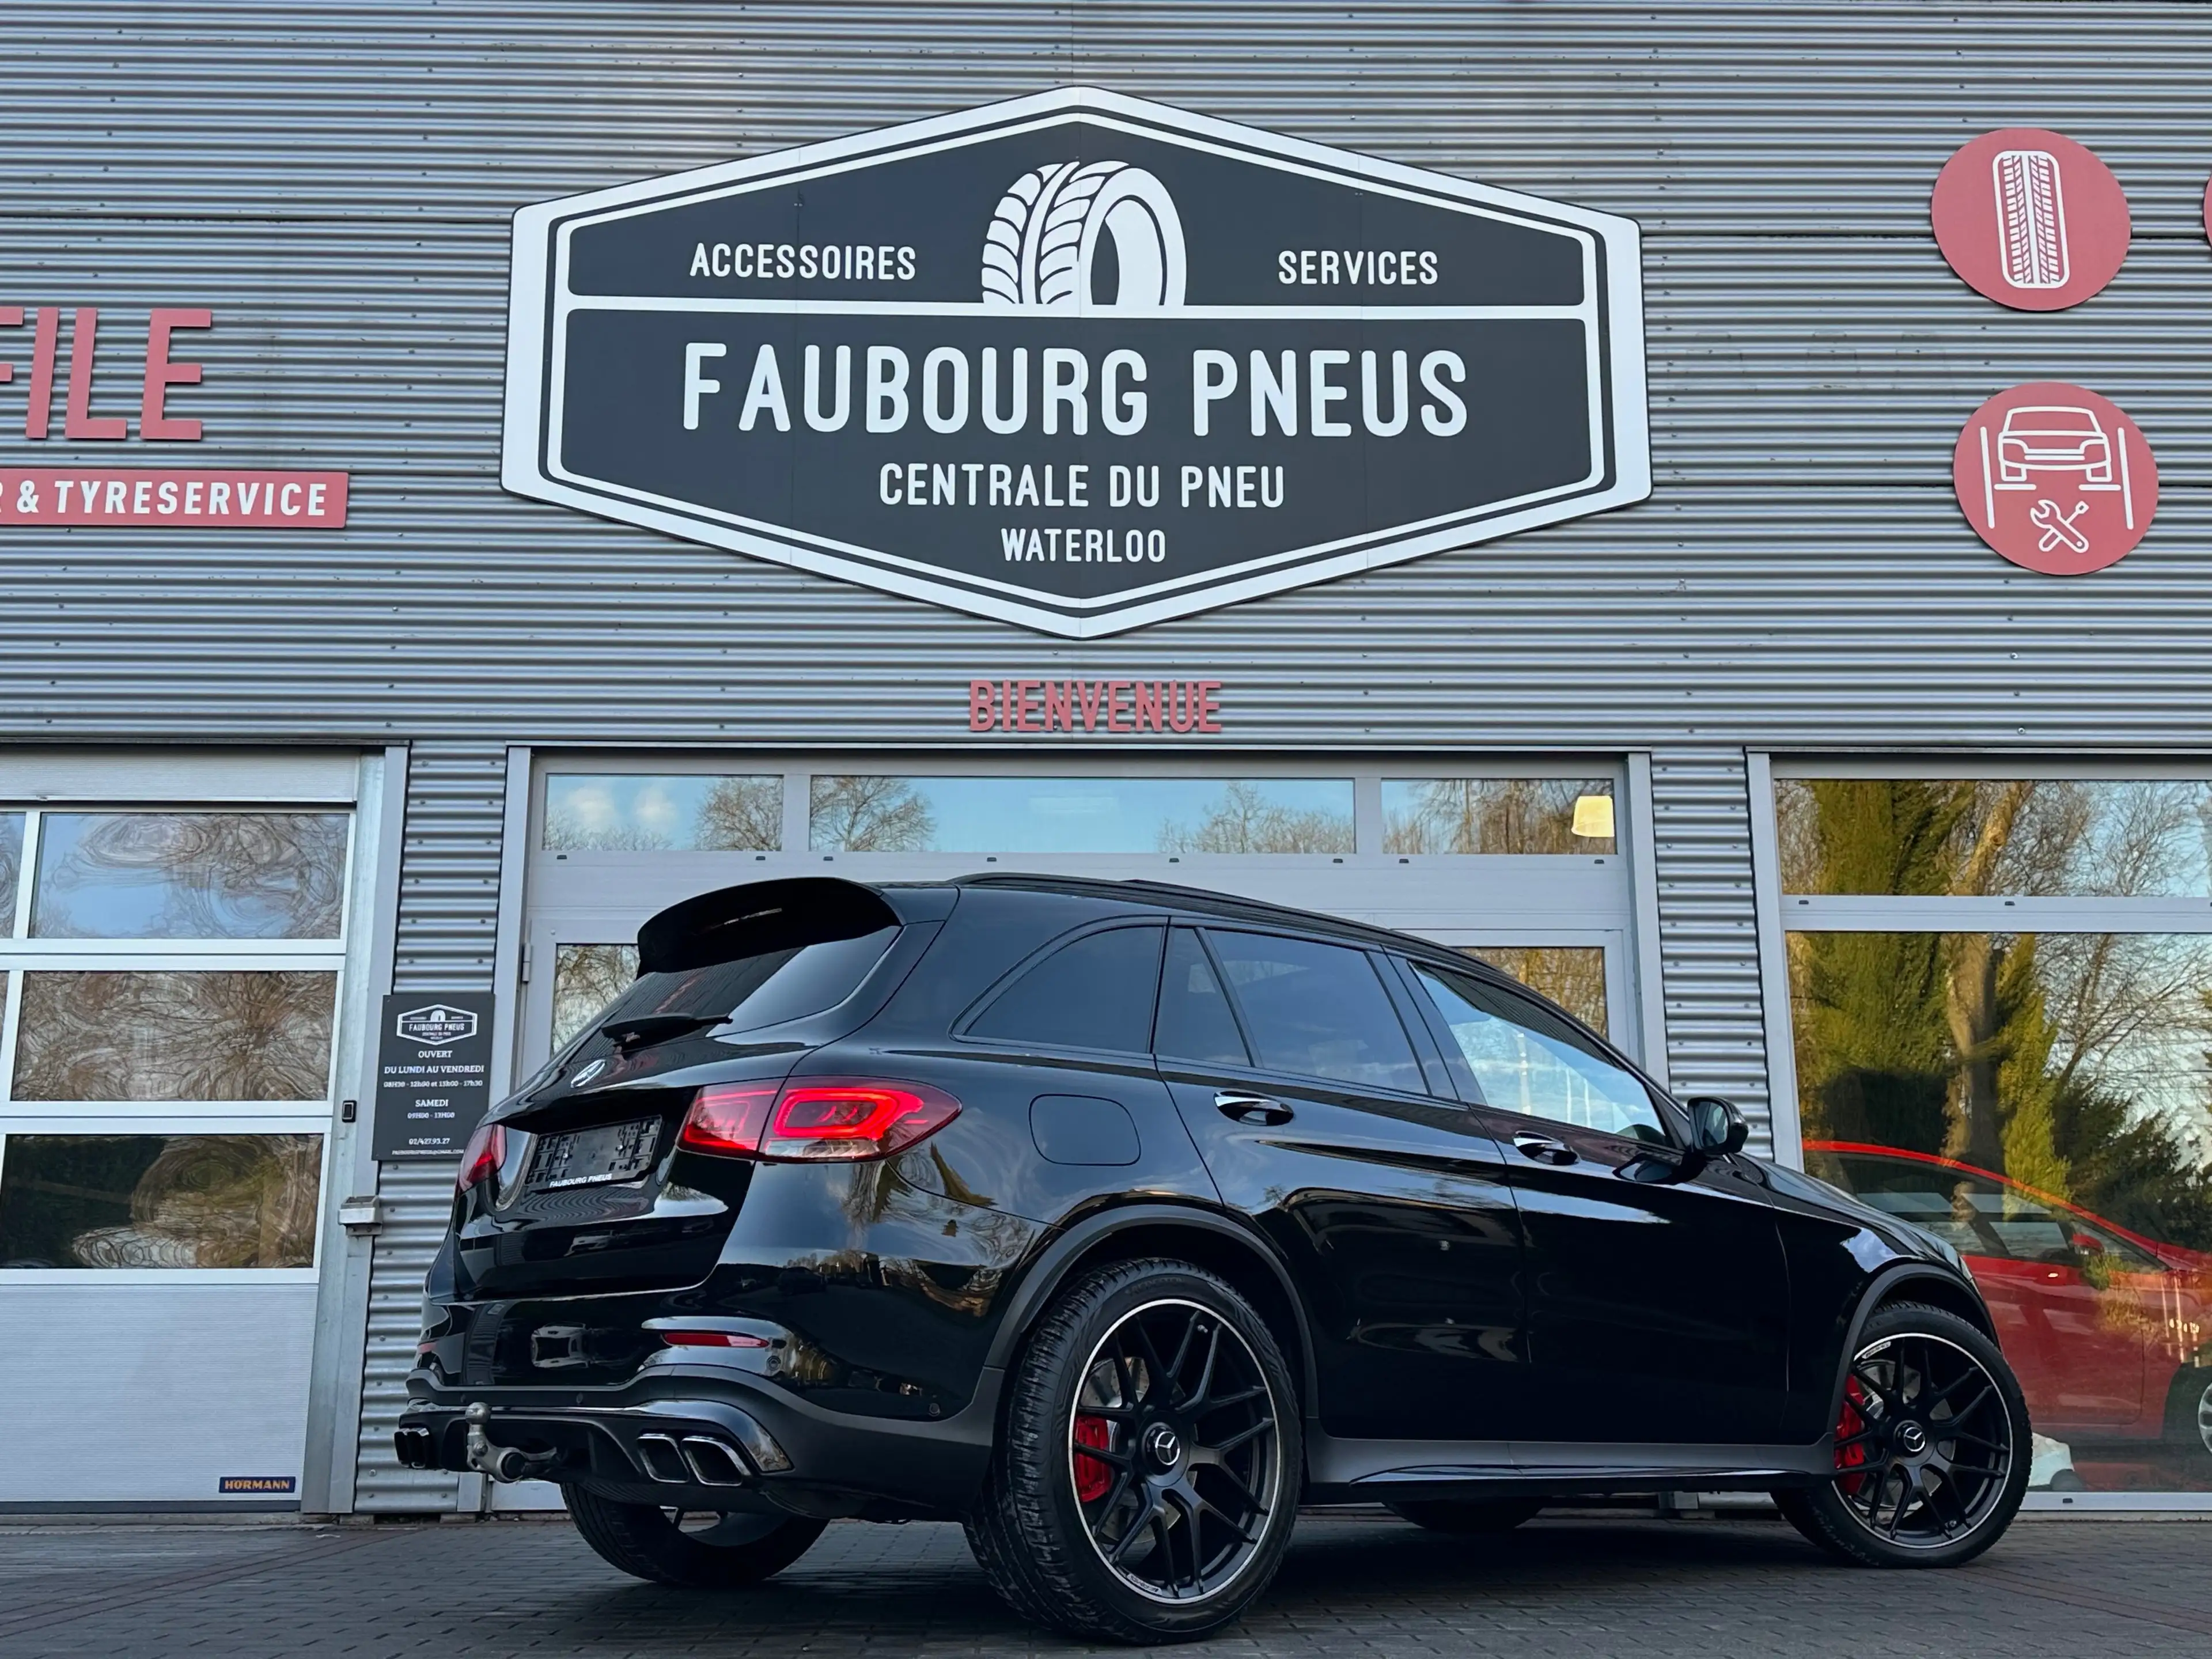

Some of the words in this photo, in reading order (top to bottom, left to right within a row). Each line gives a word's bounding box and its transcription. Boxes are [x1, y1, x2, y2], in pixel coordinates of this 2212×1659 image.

[690, 243, 916, 280] ACCESSOIRES
[1278, 250, 1438, 285] SERVICES
[0, 306, 212, 440] ILE
[683, 342, 1147, 436] FAUBOURG
[1193, 350, 1467, 437] PNEUS
[17, 480, 39, 513] &
[54, 480, 327, 516] TYRESERVICE
[880, 463, 1089, 507] CENTRALE
[1109, 465, 1159, 507] DU
[1181, 465, 1284, 508] PNEU
[1001, 528, 1165, 562] WATERLOO
[969, 679, 1222, 733] BIENVENUE
[408, 1023, 442, 1031] FAUBOURG
[444, 1023, 465, 1031] PNEUS
[398, 1066, 425, 1074] LUNDI
[440, 1065, 484, 1073] VENDREDI
[418, 1050, 453, 1058] OUVERT
[415, 1099, 449, 1107] SAMEDI
[549, 1176, 587, 1188] FAUBOURG
[588, 1173, 612, 1182] PNEUS
